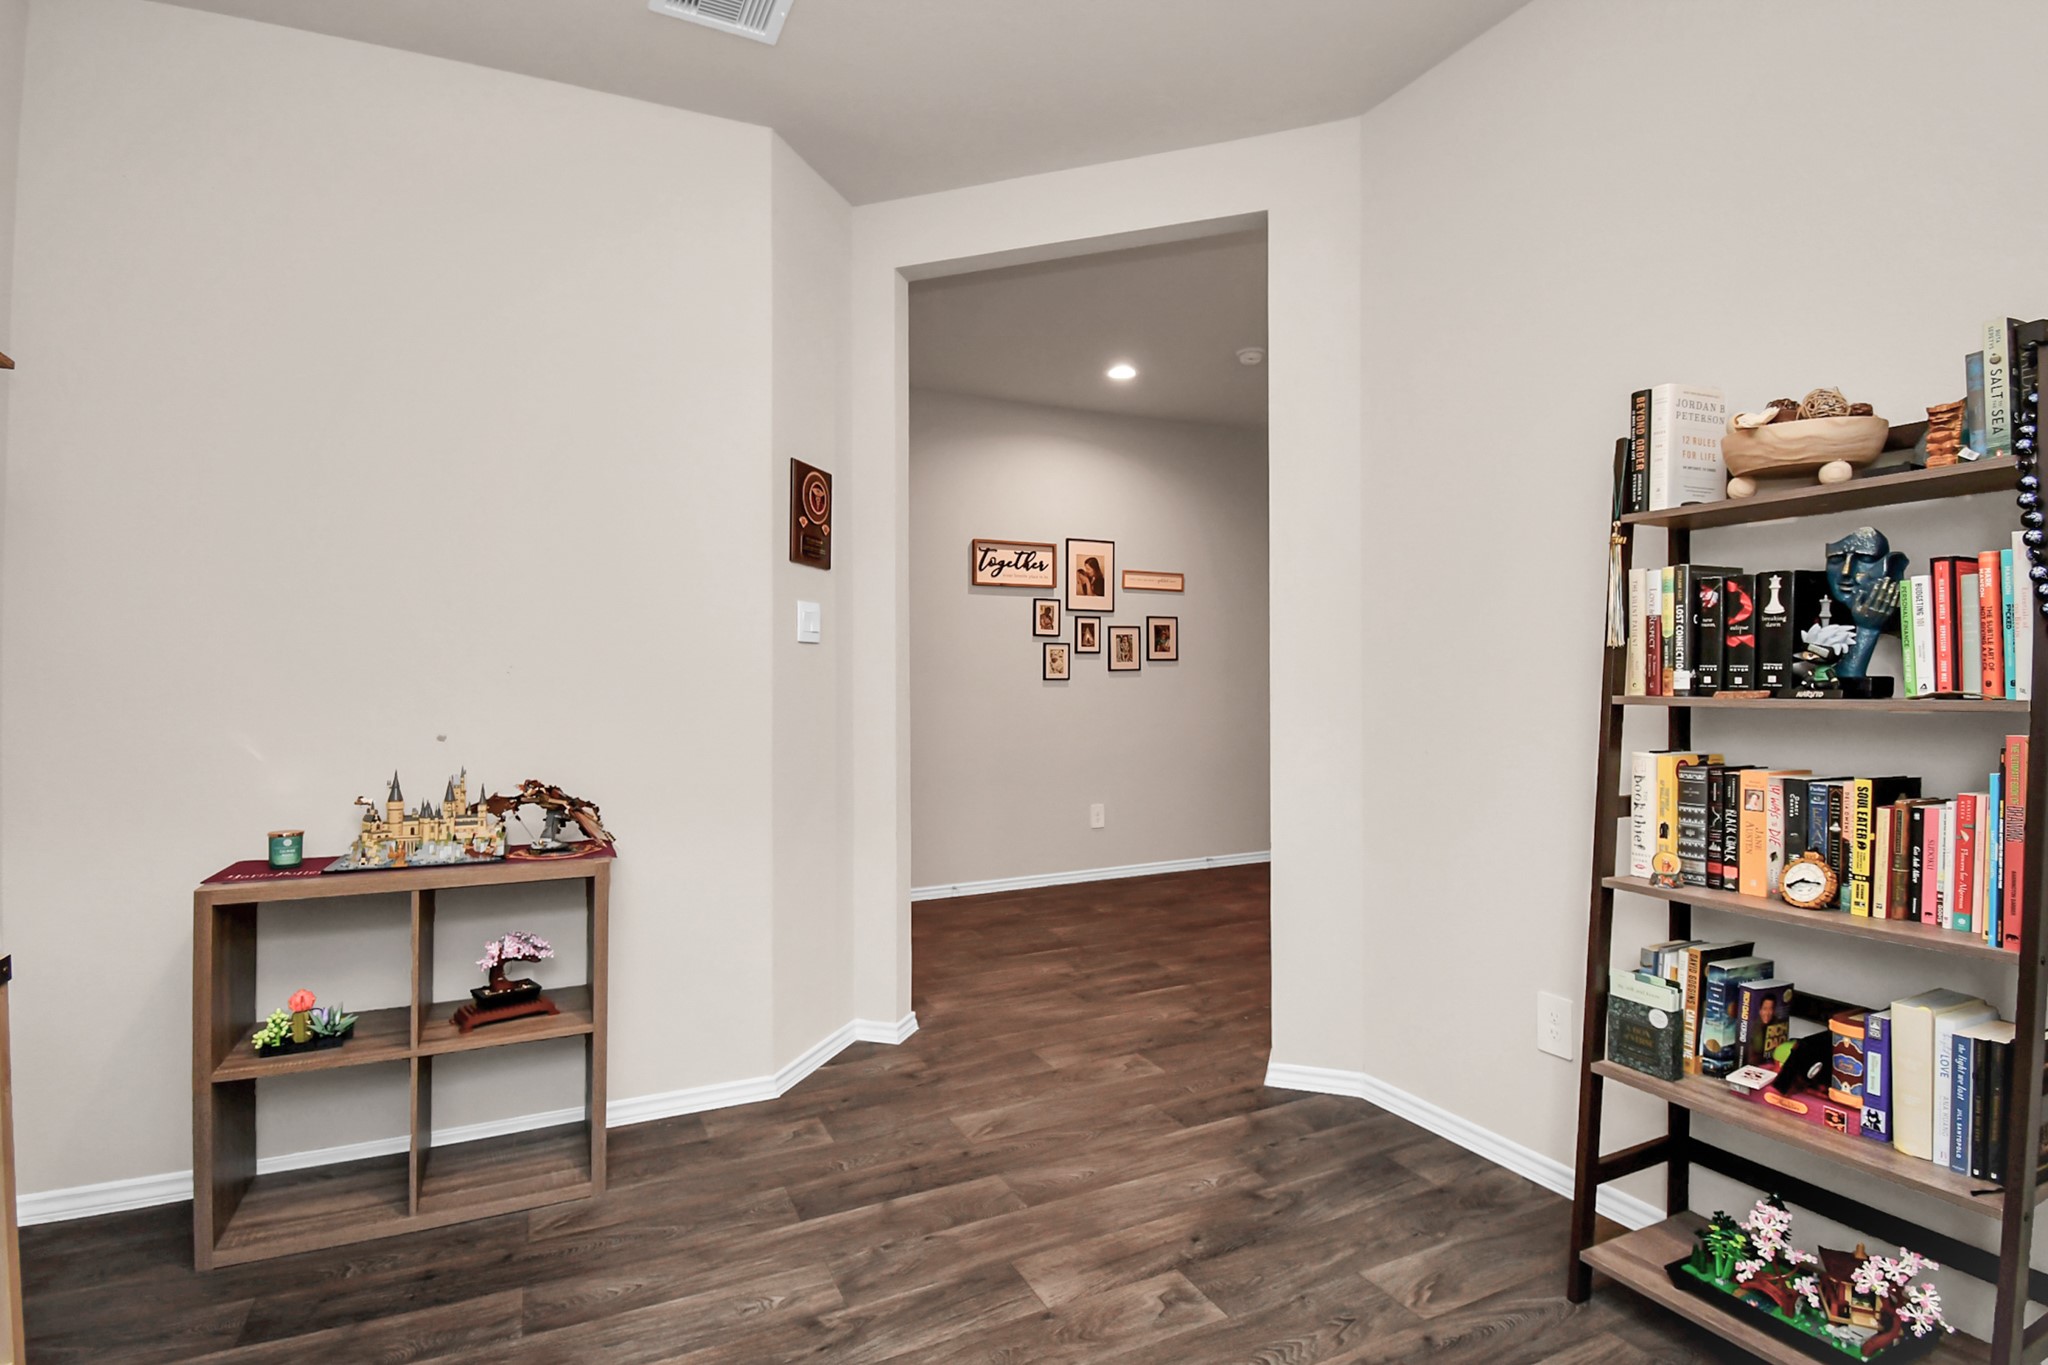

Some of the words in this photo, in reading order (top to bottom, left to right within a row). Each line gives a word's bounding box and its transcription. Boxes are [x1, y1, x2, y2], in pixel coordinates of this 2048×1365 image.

[1990, 368, 2004, 398] SALT
[1636, 396, 1646, 435] BEYOND
[1676, 399, 1717, 412] JORDAN
[1720, 404, 1726, 414] B
[1676, 411, 1726, 424] PETERSON
[1992, 409, 2004, 435] SEA
[1682, 436, 1690, 445] 12
[1692, 436, 1716, 448] RULES
[1636, 439, 1644, 470] ORDER
[1682, 450, 1696, 460] FOR
[1700, 450, 1716, 462] LIFE
[978, 546, 1049, 578] Together
[1915, 583, 1924, 616] BUDGETING
[1730, 624, 1748, 634] eclipse
[1676, 625, 1684, 672] CONNECTIO
[1988, 662, 1995, 671] OF
[1634, 774, 1646, 810] book
[1857, 786, 1869, 809] SOUL
[1770, 796, 1780, 820] WAYS
[1634, 814, 1646, 850] thief
[1726, 808, 1738, 834] BLACK
[1856, 810, 1868, 840] EATER
[2006, 806, 2024, 843] DRAWING
[1724, 836, 1738, 862] CHALK
[1746, 821, 1754, 854] AUSTEN
[1755, 827, 1764, 850] JANE
[1768, 828, 1782, 848] DIE
[1912, 846, 1920, 856] Go
[1912, 856, 1920, 868] Ask
[1927, 839, 1935, 870] SUDOKU
[1912, 868, 1920, 883] Alice
[1960, 872, 1968, 880] for
[1958, 882, 1968, 909] Algernon
[1689, 954, 1698, 974] DAVID
[1687, 975, 1698, 1004] GOGGINS
[1686, 1009, 1694, 1028] CAN'T
[1684, 1030, 1694, 1048] HURT
[1958, 1044, 1966, 1054] the
[1684, 1048, 1692, 1059] ME
[1954, 1054, 1967, 1074] light
[1940, 1054, 1950, 1078] LOVE
[1958, 1075, 1964, 1084] we
[1957, 1086, 1966, 1100] lost
